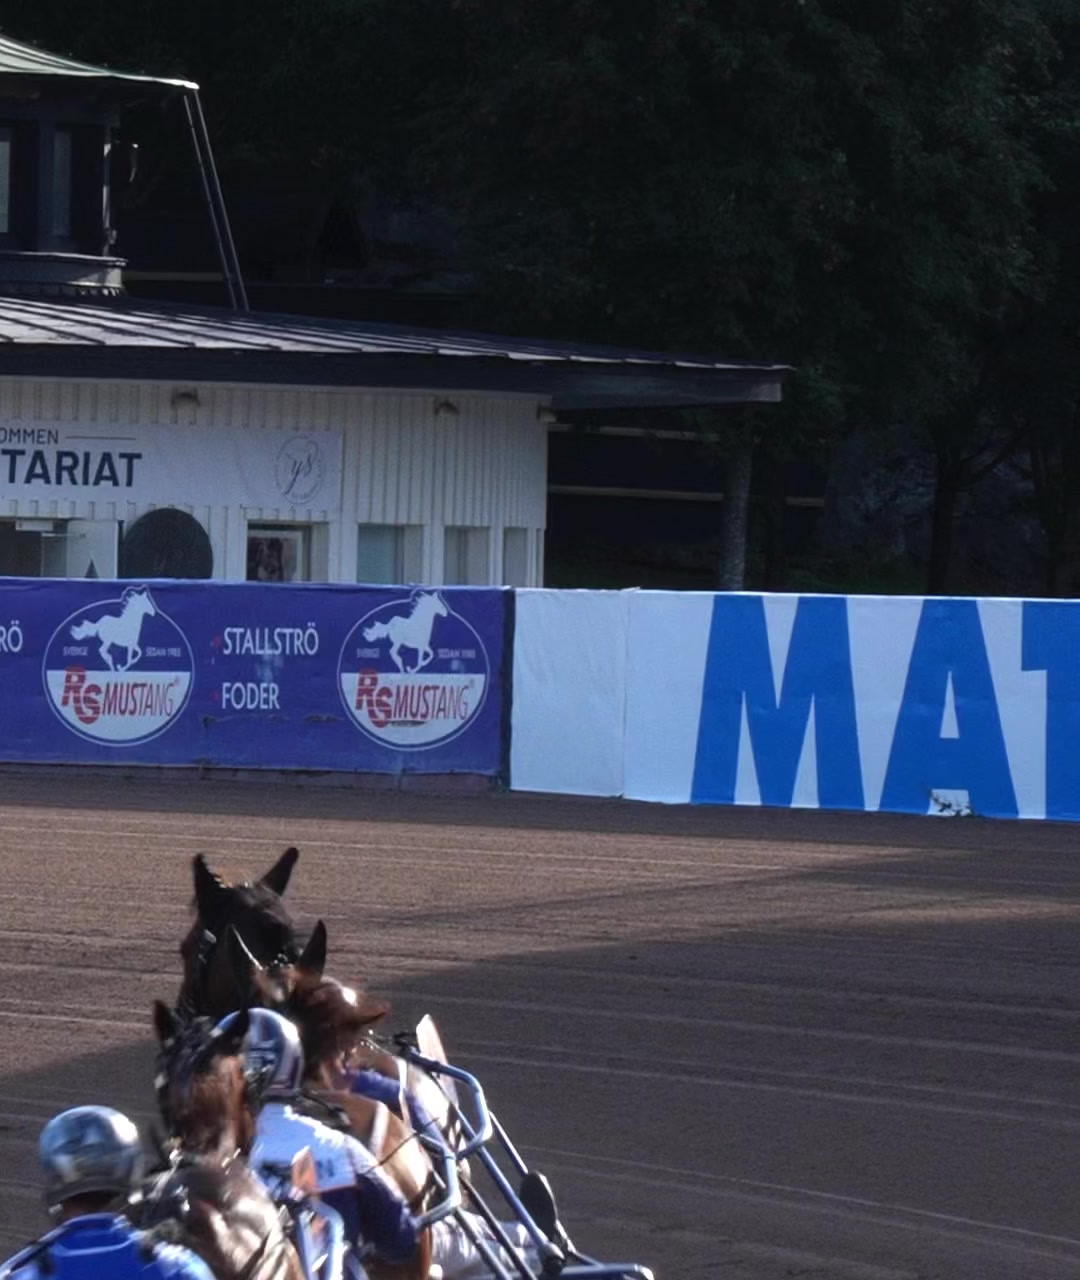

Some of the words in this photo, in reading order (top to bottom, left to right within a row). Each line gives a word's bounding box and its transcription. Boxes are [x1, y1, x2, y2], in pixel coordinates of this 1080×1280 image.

[223, 622, 319, 656] STALLSTRÖ
[101, 682, 173, 716] MUSTANG
[221, 682, 280, 710] FODER
[393, 684, 469, 720] MUSTANG
